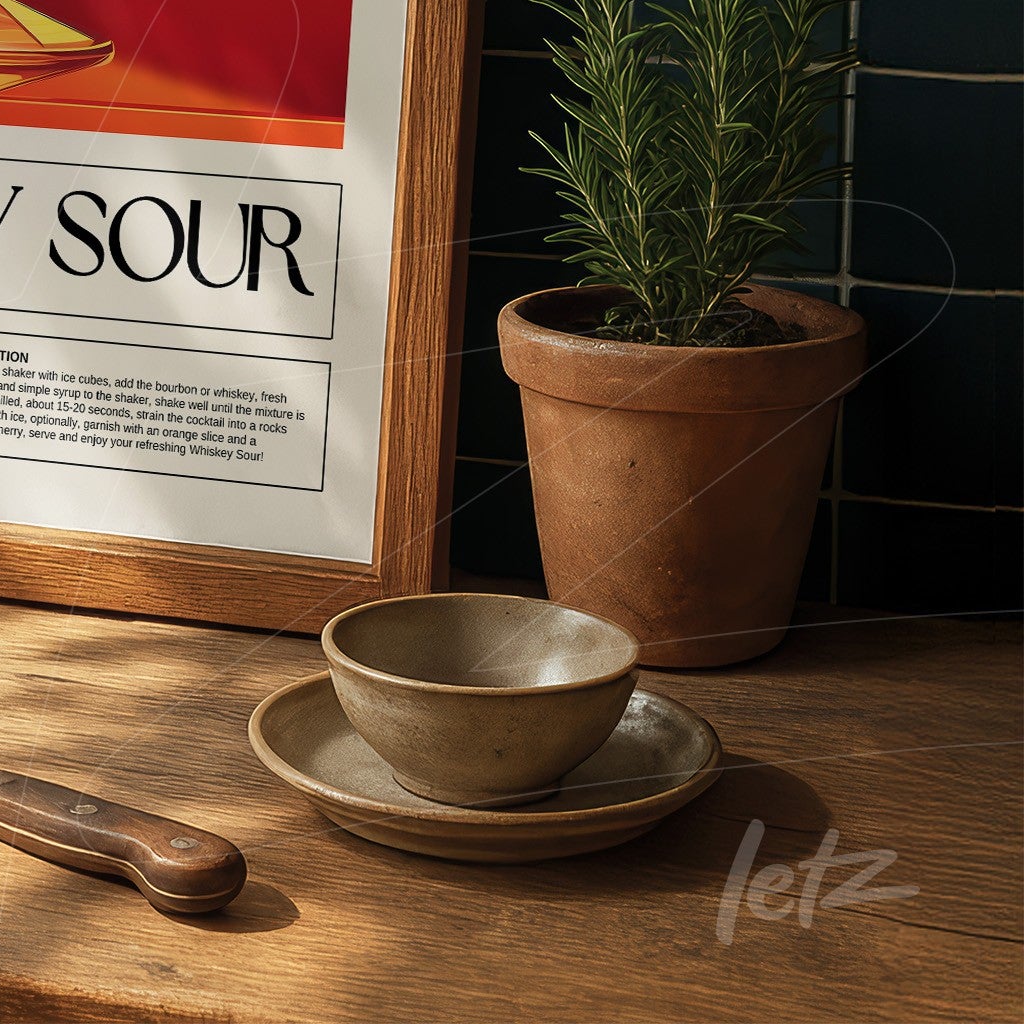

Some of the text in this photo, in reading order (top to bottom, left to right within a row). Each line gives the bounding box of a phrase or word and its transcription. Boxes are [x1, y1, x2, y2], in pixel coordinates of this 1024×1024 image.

[48, 190, 315, 297] SOUR
[1, 366, 36, 379] shaker
[38, 370, 58, 381] with
[61, 371, 76, 383] ice
[78, 374, 111, 388] cubes,
[114, 378, 134, 389] add
[136, 379, 153, 391] the
[155, 381, 197, 395] bourbon
[200, 387, 211, 396] or
[213, 387, 257, 403] whiskey,
[261, 391, 287, 404] fresh
[18, 382, 50, 397] simple
[53, 387, 81, 400] syrup
[83, 390, 94, 399] to
[95, 390, 112, 401] the
[114, 392, 151, 407] shaker,
[154, 396, 185, 409] shake
[187, 400, 209, 411] well
[211, 402, 233, 413] until
[235, 404, 252, 415] the
[255, 406, 293, 419] mixture
[296, 409, 305, 420] is
[9, 410, 27, 424] ice,
[30, 414, 80, 430] optionally,
[83, 420, 120, 432] garnish
[122, 423, 143, 434] with
[146, 427, 160, 436] an
[162, 428, 198, 442] orange
[200, 430, 224, 443] slice
[227, 434, 247, 445] and
[249, 437, 257, 446] a
[25, 398, 54, 410] about
[56, 401, 86, 413] 15-20
[88, 405, 133, 420] seconds,
[136, 410, 164, 421] strain
[167, 412, 183, 424] the
[185, 415, 225, 427] cocktail
[227, 417, 247, 430] into
[249, 422, 256, 431] a
[259, 422, 287, 434] rocks
[28, 429, 56, 440] serve
[58, 432, 78, 442] and
[80, 433, 108, 448] enjoy
[110, 438, 133, 448] your
[135, 439, 186, 456] refreshing
[189, 444, 234, 461] Whiskey
[235, 449, 263, 461] Sour!
